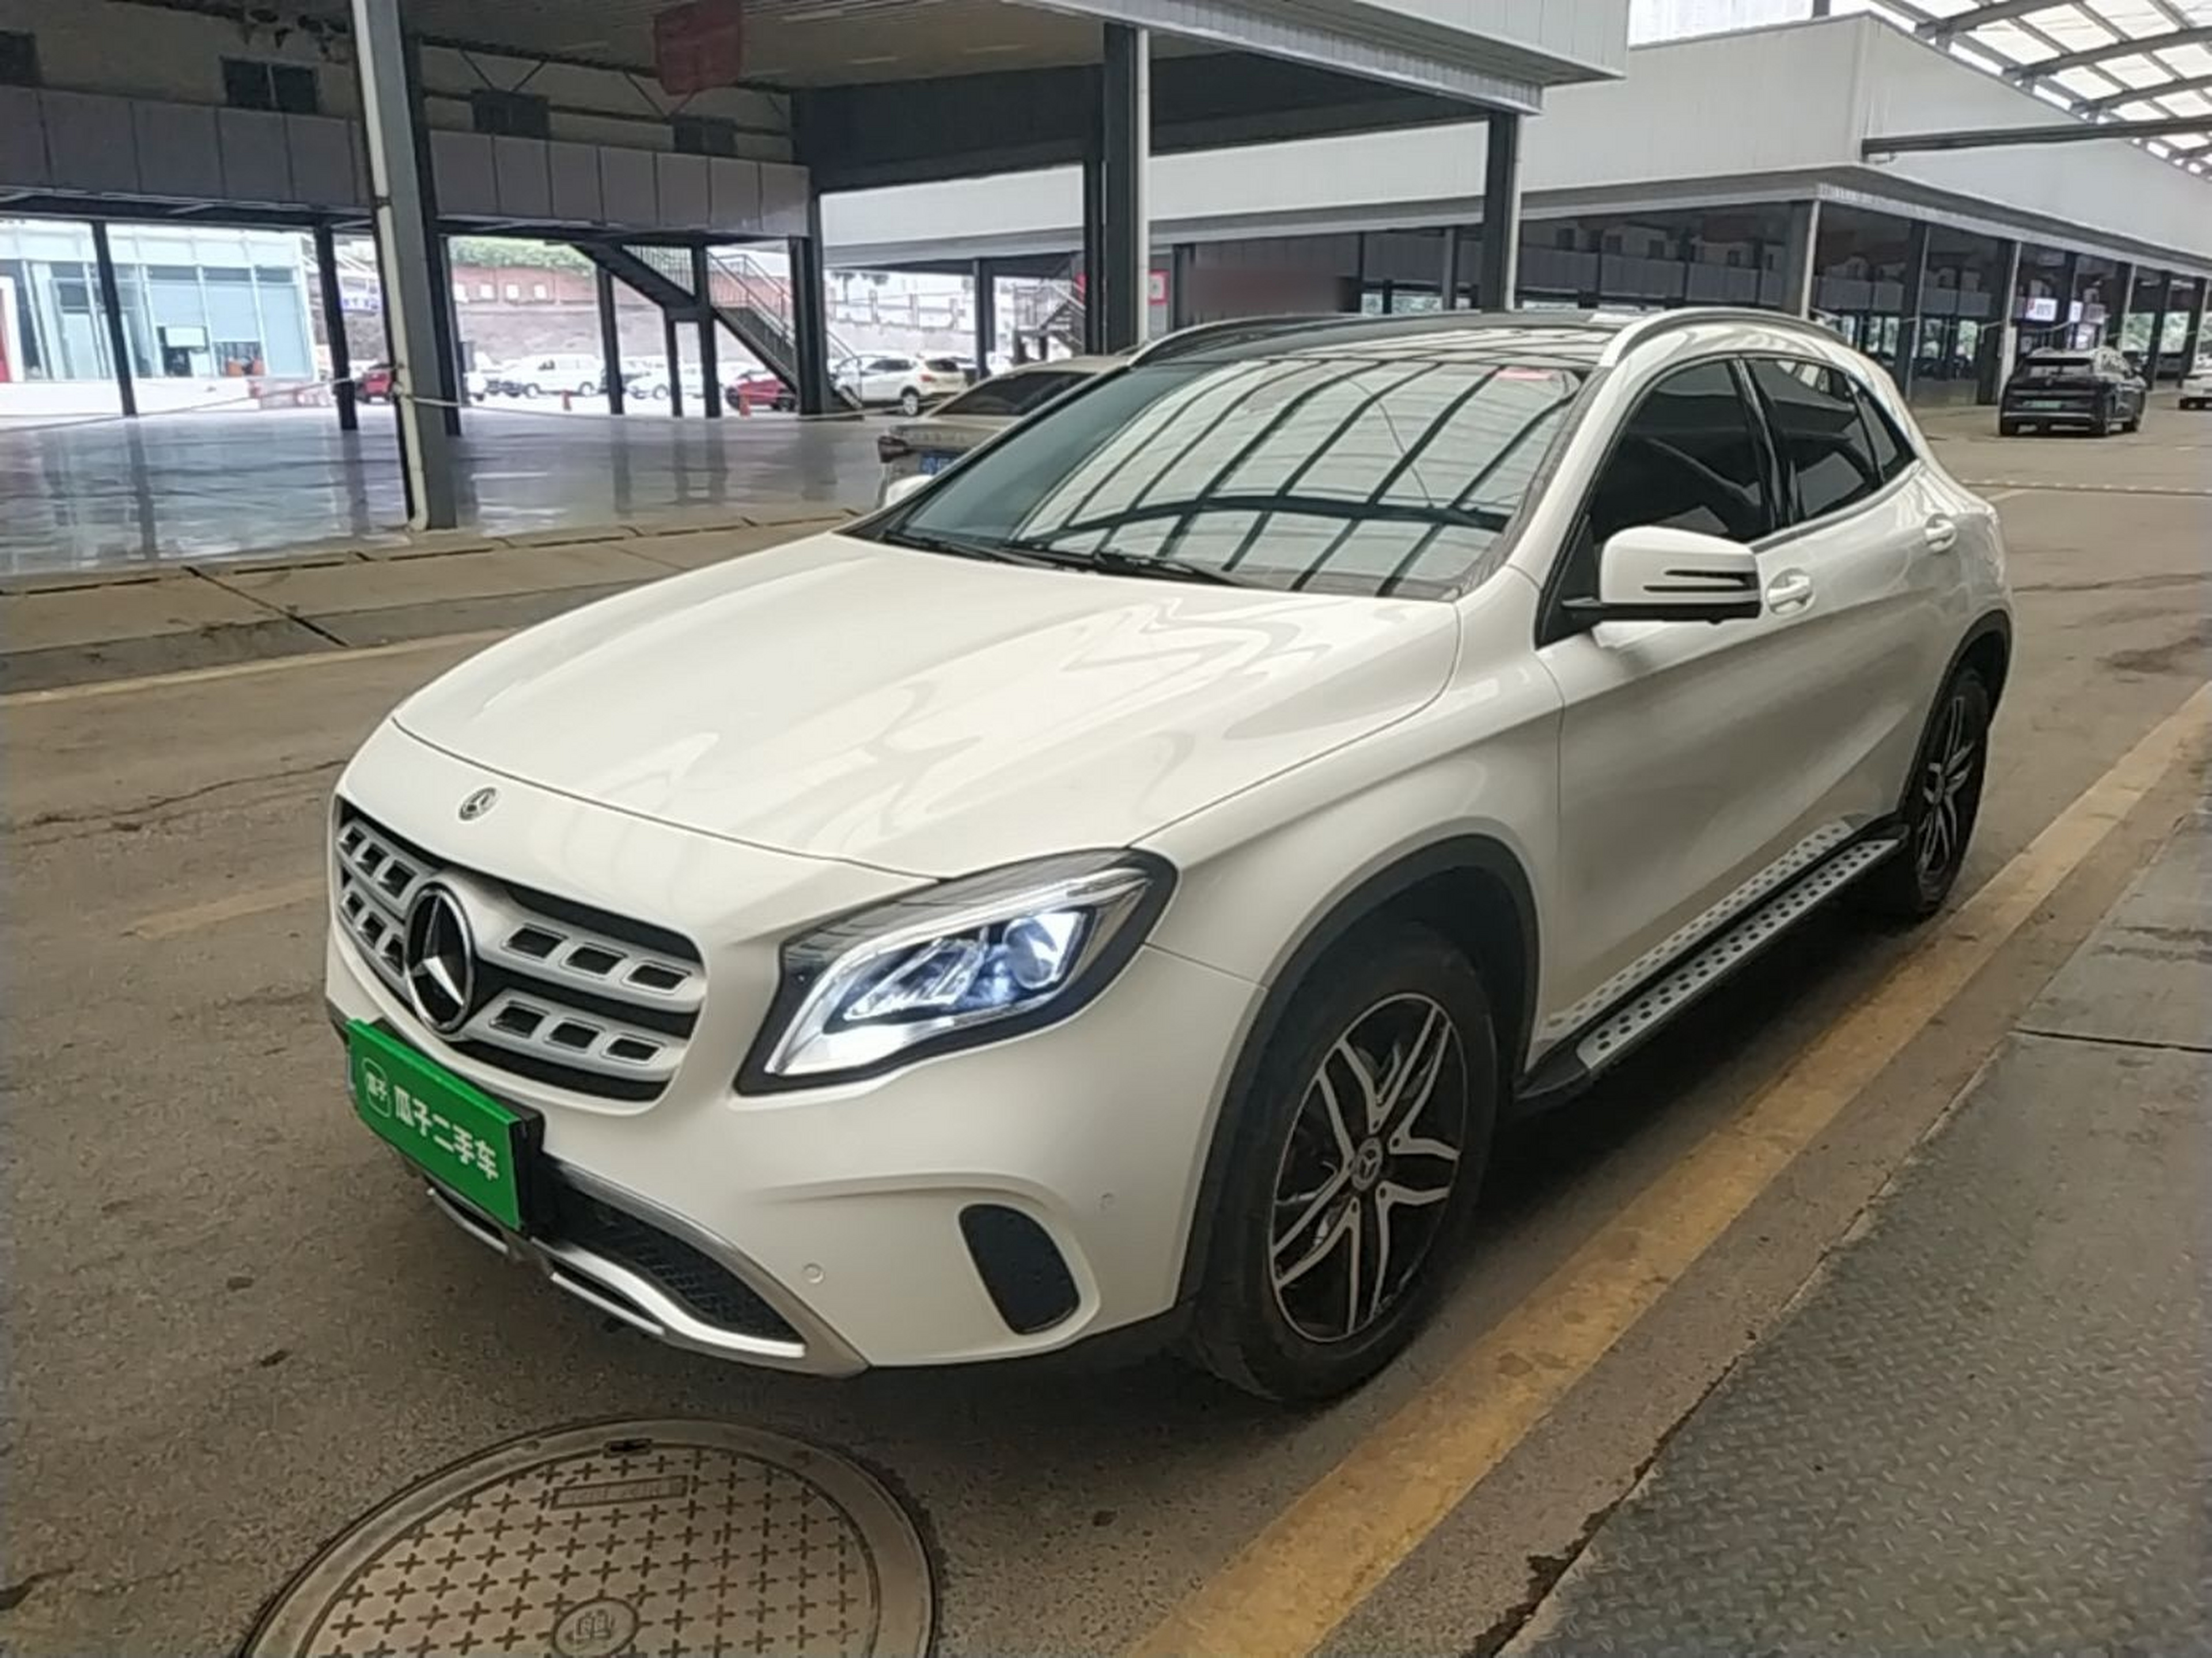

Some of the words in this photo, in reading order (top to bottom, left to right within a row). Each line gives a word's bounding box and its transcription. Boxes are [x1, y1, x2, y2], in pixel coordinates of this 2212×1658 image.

[394, 1085, 499, 1181] 瓜子二手车
